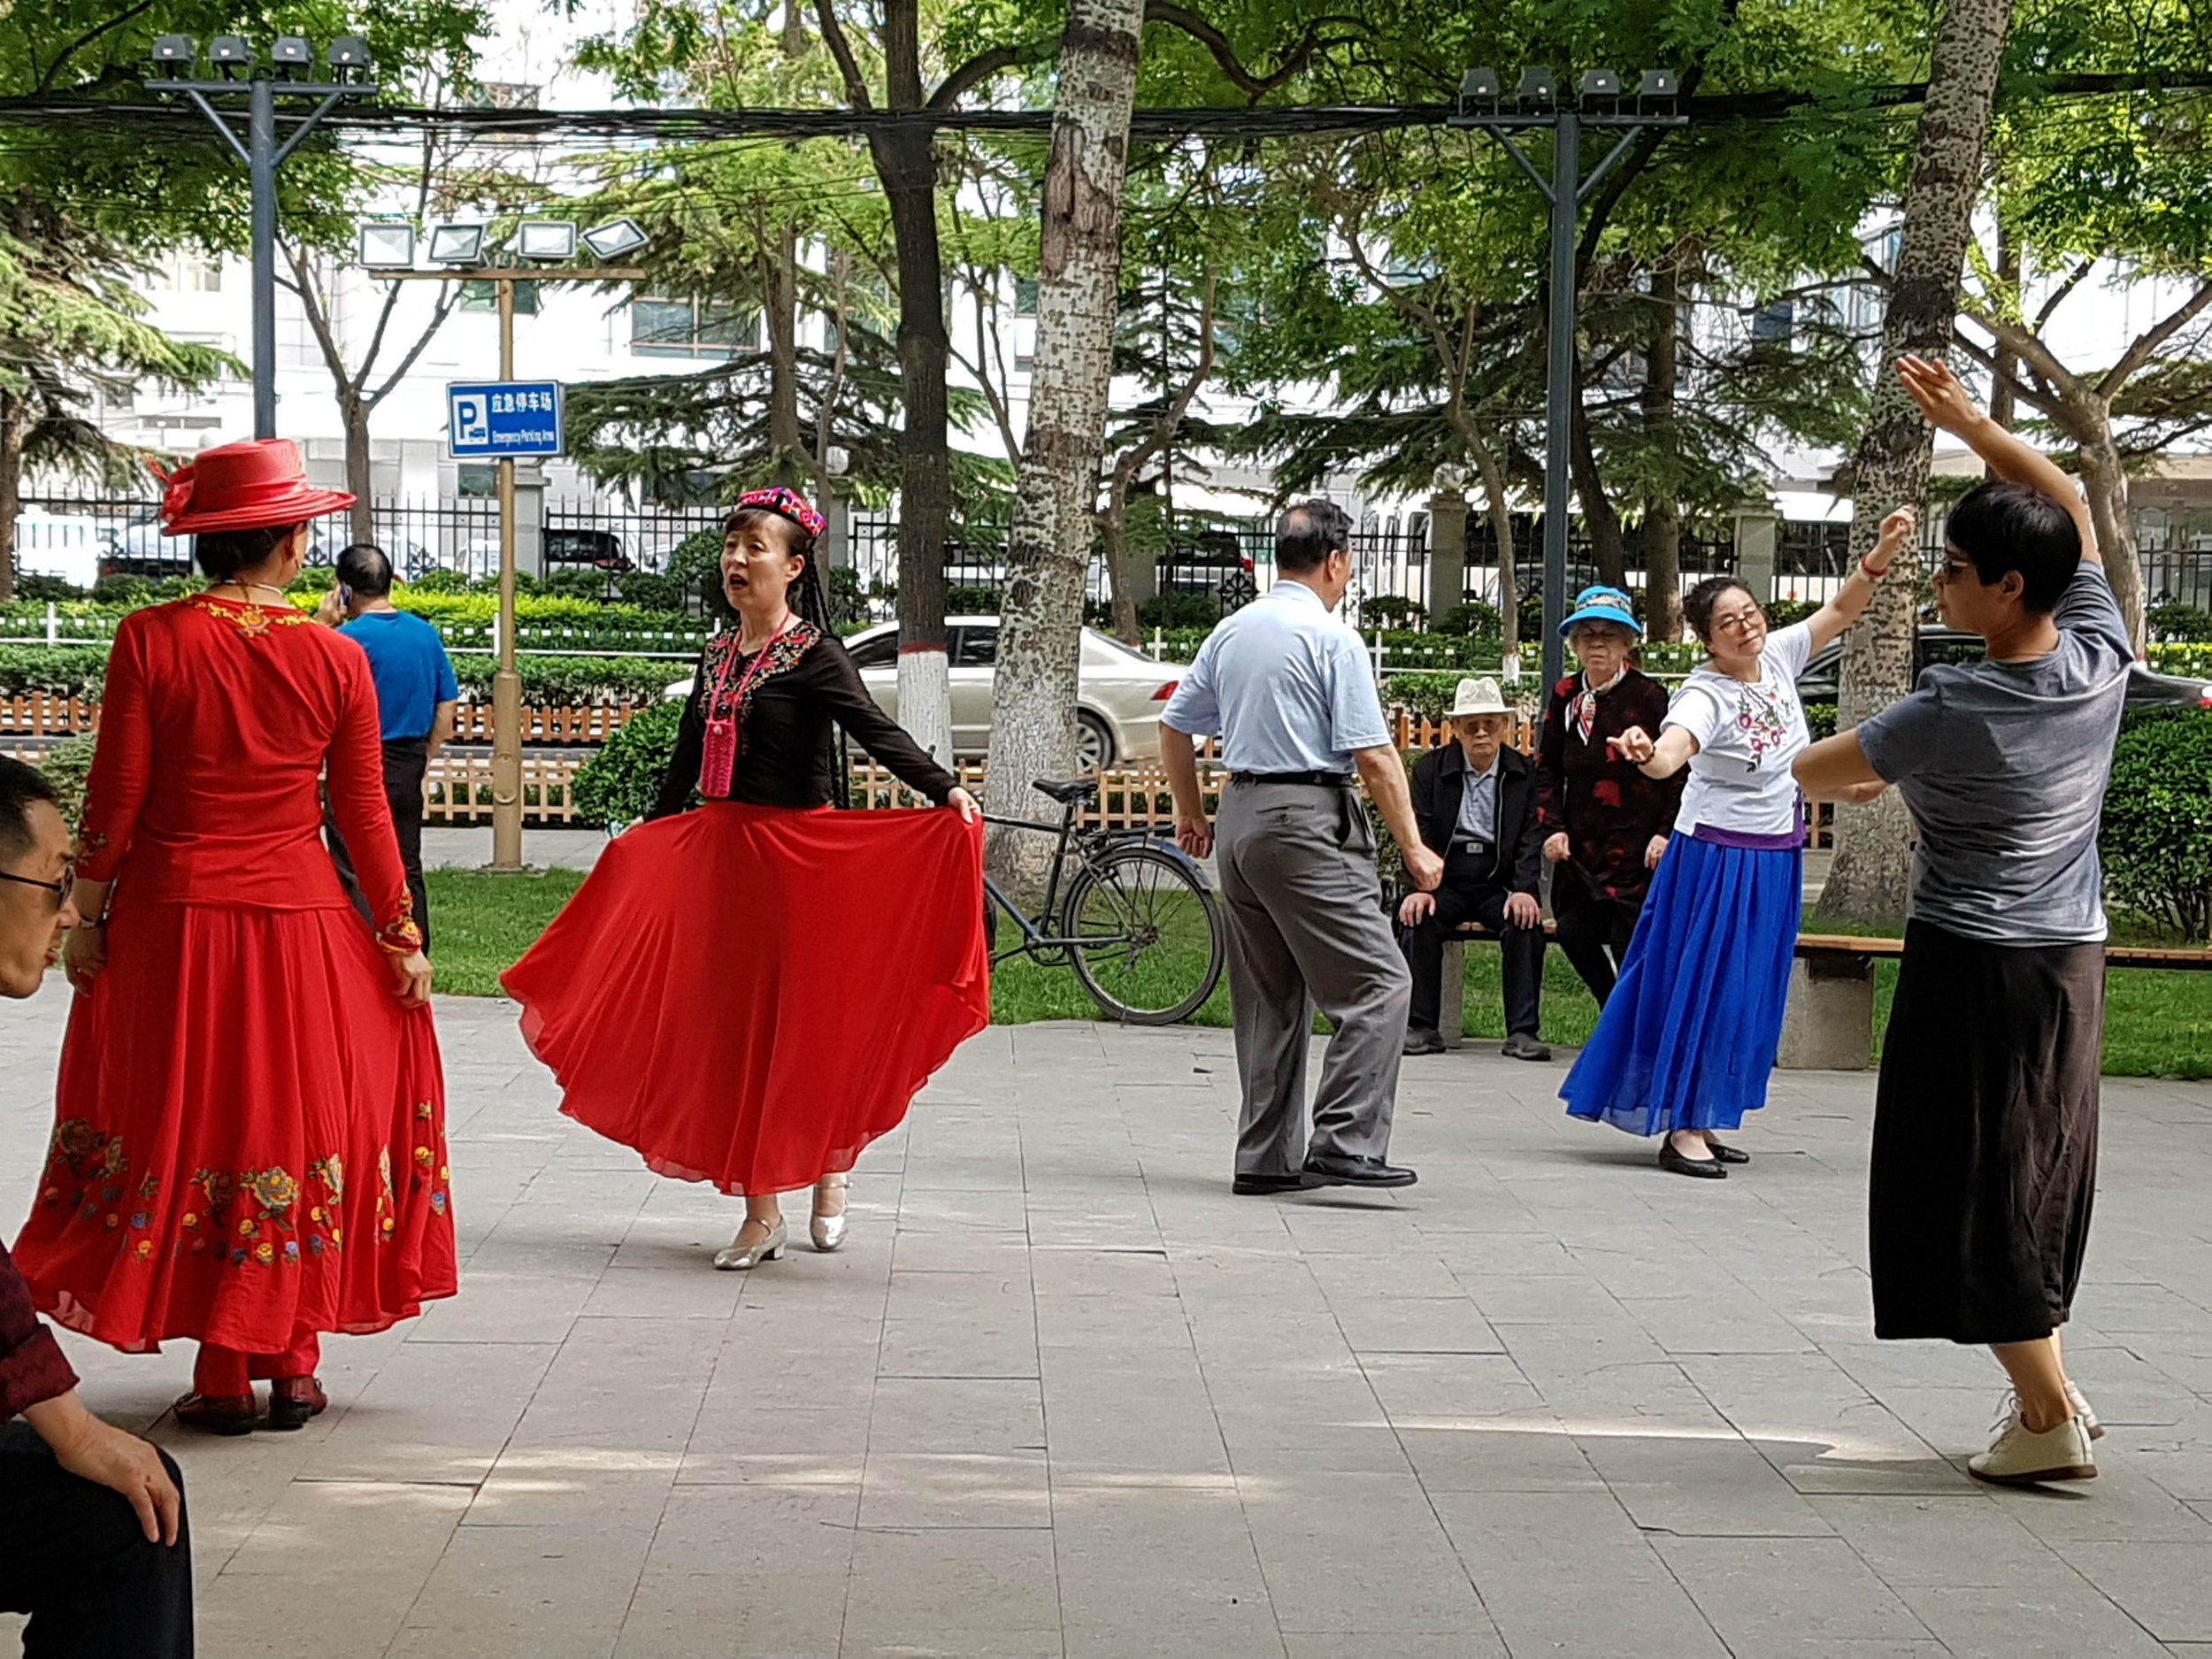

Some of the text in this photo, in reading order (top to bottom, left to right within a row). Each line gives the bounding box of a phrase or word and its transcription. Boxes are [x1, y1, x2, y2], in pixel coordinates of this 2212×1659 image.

[491, 391, 552, 412] 应急停车场
[457, 401, 478, 439] P
